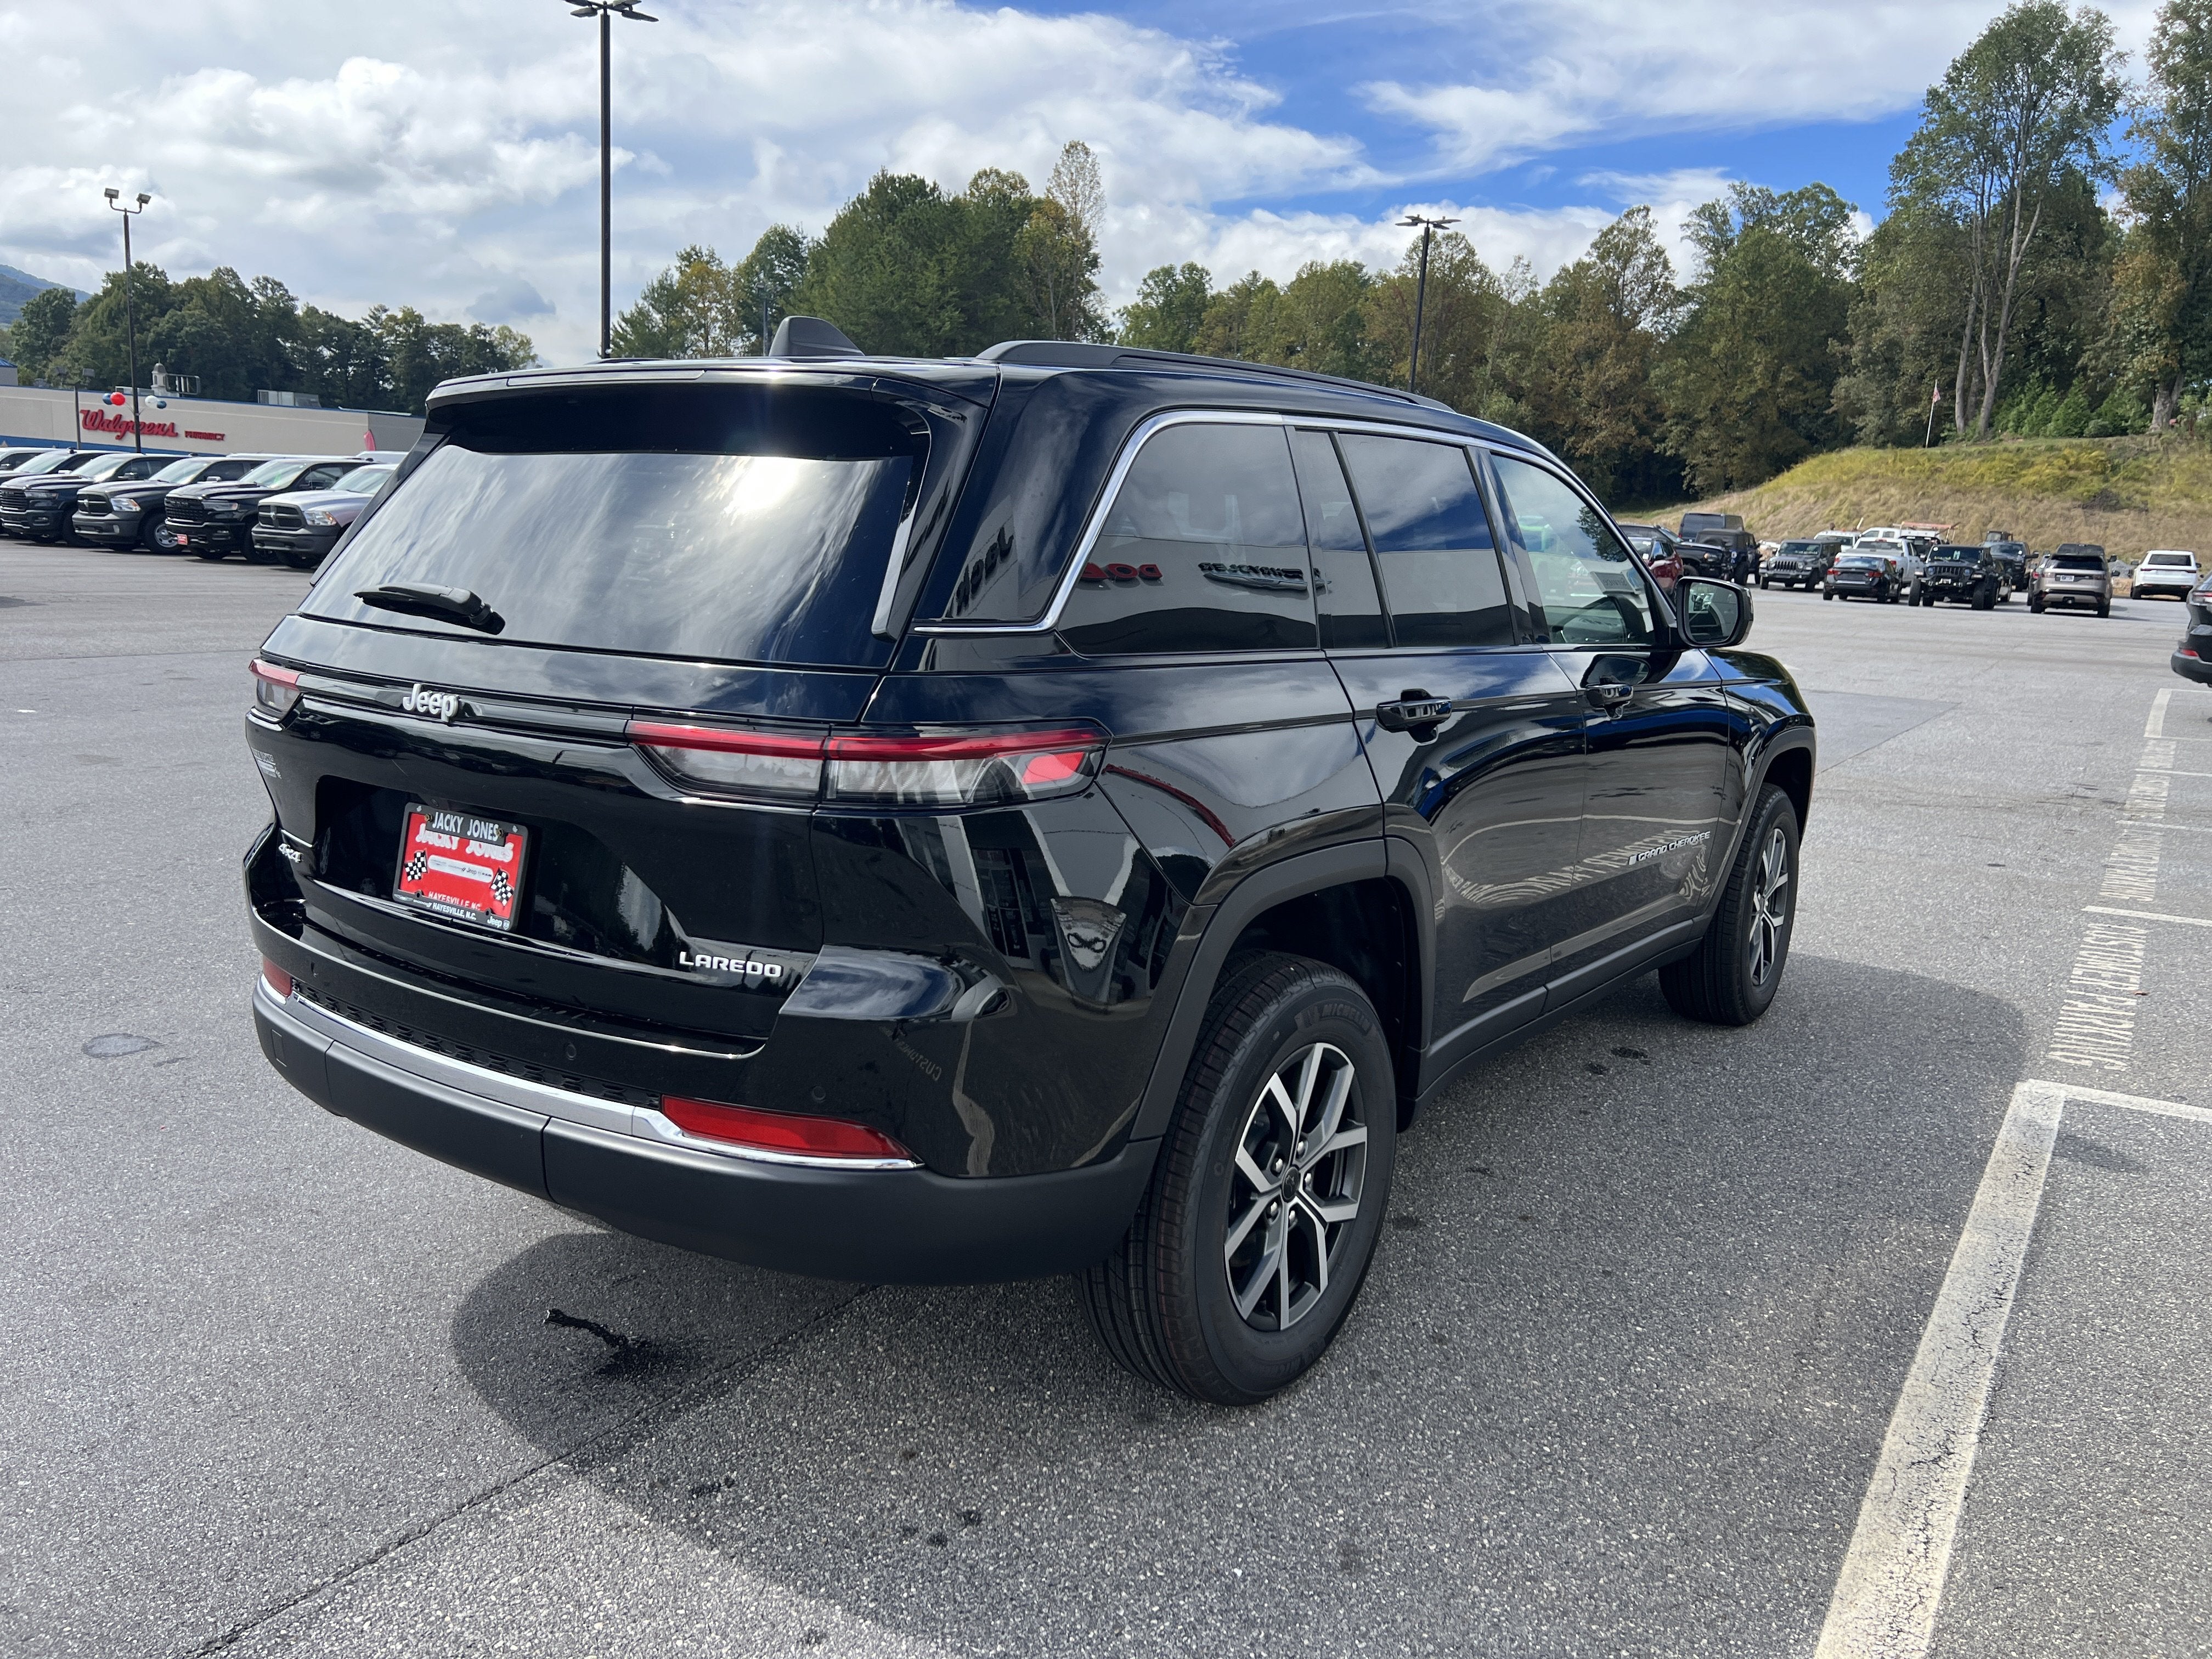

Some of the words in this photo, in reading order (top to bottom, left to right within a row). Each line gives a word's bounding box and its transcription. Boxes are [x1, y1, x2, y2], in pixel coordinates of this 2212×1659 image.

[80, 409, 178, 441] Walgreens
[403, 684, 459, 723] Jeep
[432, 811, 464, 833] JACKY
[467, 819, 499, 842] JONES
[1638, 845, 1668, 862] GRAND
[1668, 831, 1711, 851] CHEROKEE
[428, 891, 470, 907] HAYESVILLE
[432, 902, 465, 918] HAYESVILLE,
[487, 916, 503, 928] Jeep
[680, 951, 782, 978] LAREDO
[2067, 923, 2147, 991] CUSTOMER
[2047, 990, 2137, 1070] PARKING
